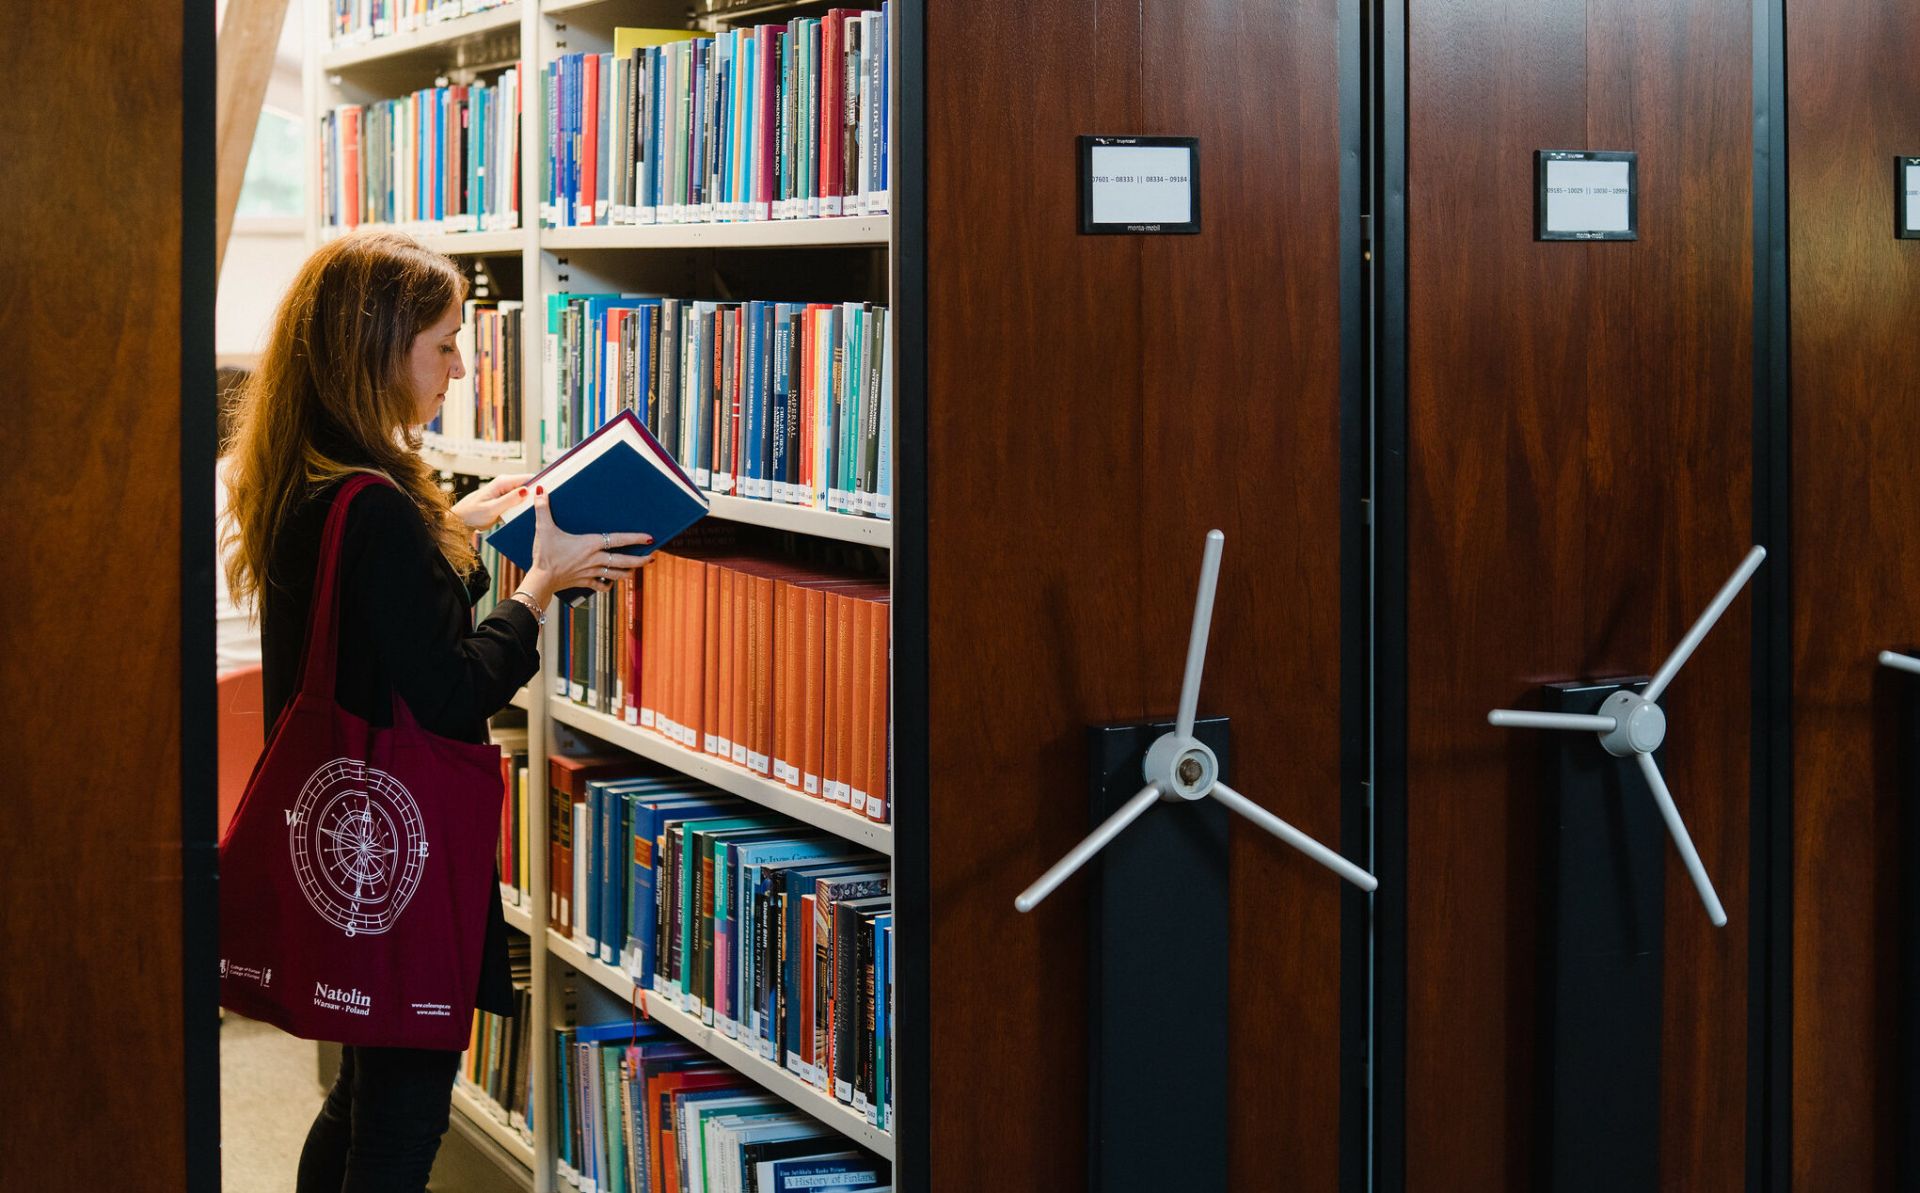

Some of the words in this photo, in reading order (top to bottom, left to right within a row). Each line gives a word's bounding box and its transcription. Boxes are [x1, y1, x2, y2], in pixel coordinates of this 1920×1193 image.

[866, 964, 875, 995] TAMED
[313, 998, 340, 1011] Warsaw
[345, 1005, 370, 1016] Poland
[315, 981, 371, 1007] Natolin
[866, 997, 875, 1031] POWER
[786, 1178, 793, 1187] A
[795, 1176, 829, 1188] History
[832, 1175, 841, 1184] of
